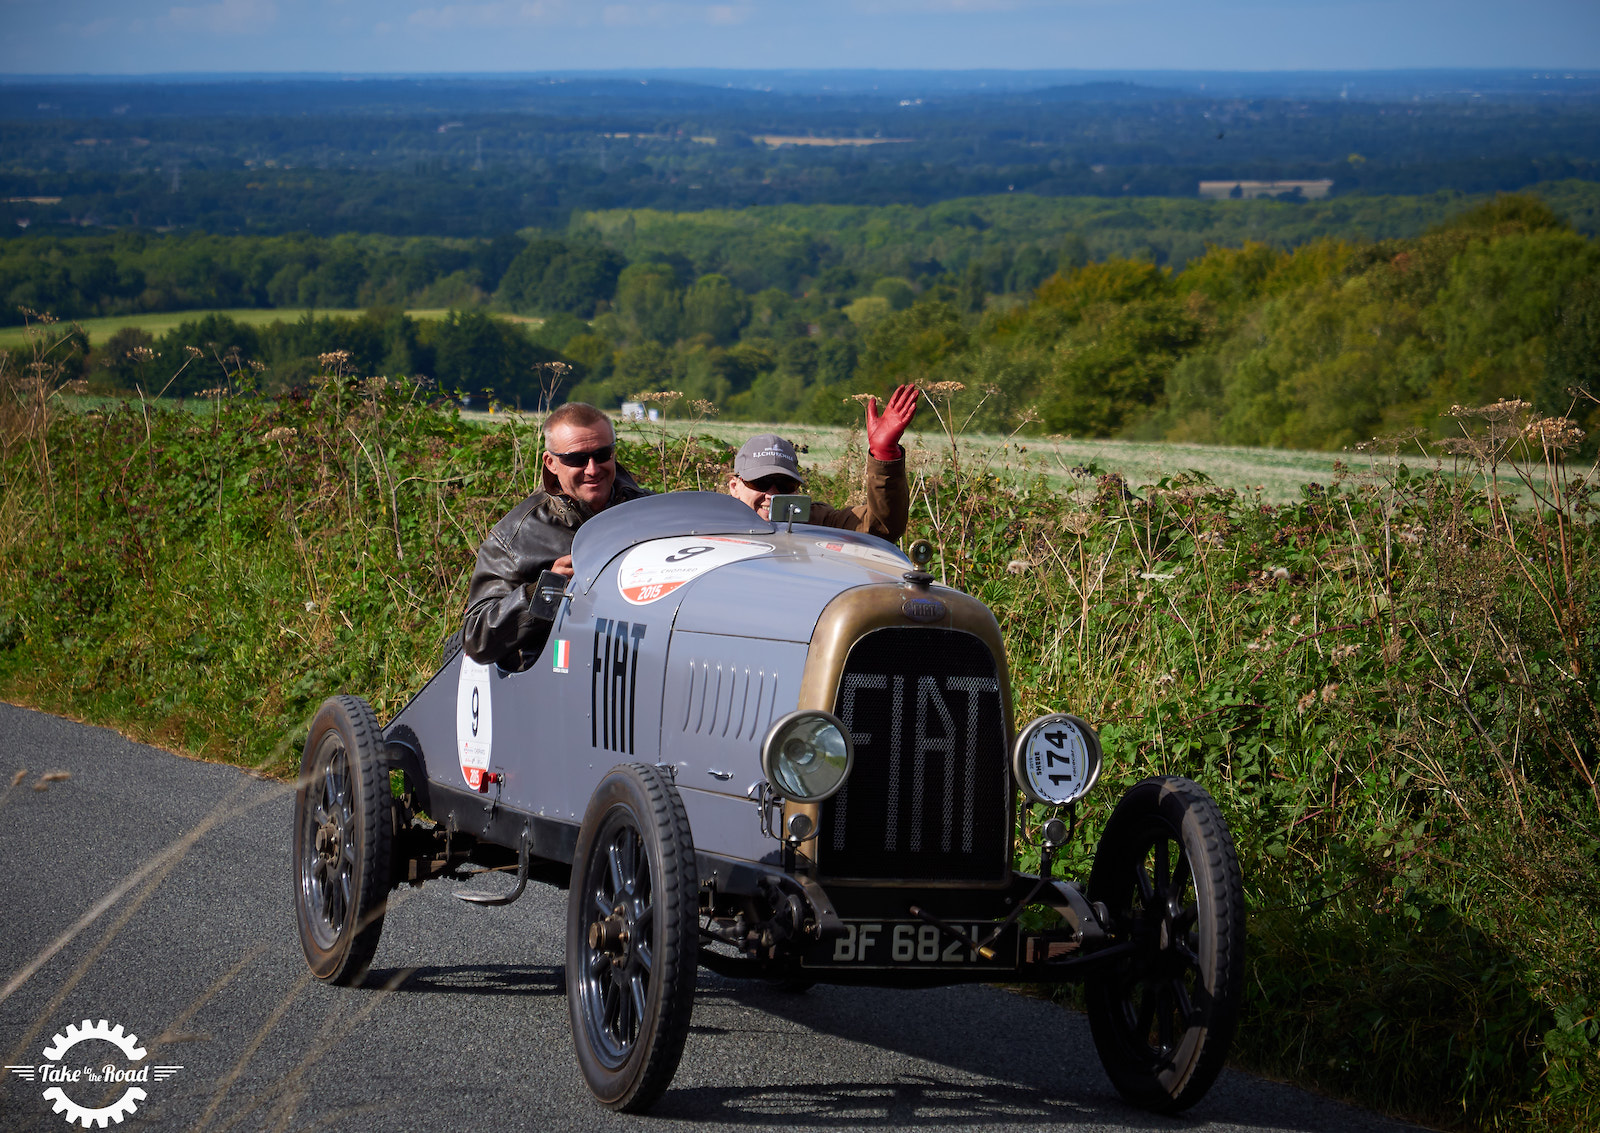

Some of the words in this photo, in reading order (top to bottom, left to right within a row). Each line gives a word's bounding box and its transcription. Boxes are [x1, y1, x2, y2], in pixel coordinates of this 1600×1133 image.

[665, 546, 715, 563] 9
[637, 585, 663, 600] 2015
[592, 617, 647, 755] FIAT
[472, 686, 479, 737] 9
[833, 673, 998, 853] FIAT
[1034, 751, 1042, 776] SHERE
[1045, 730, 1072, 786] 174
[833, 924, 882, 961] BF
